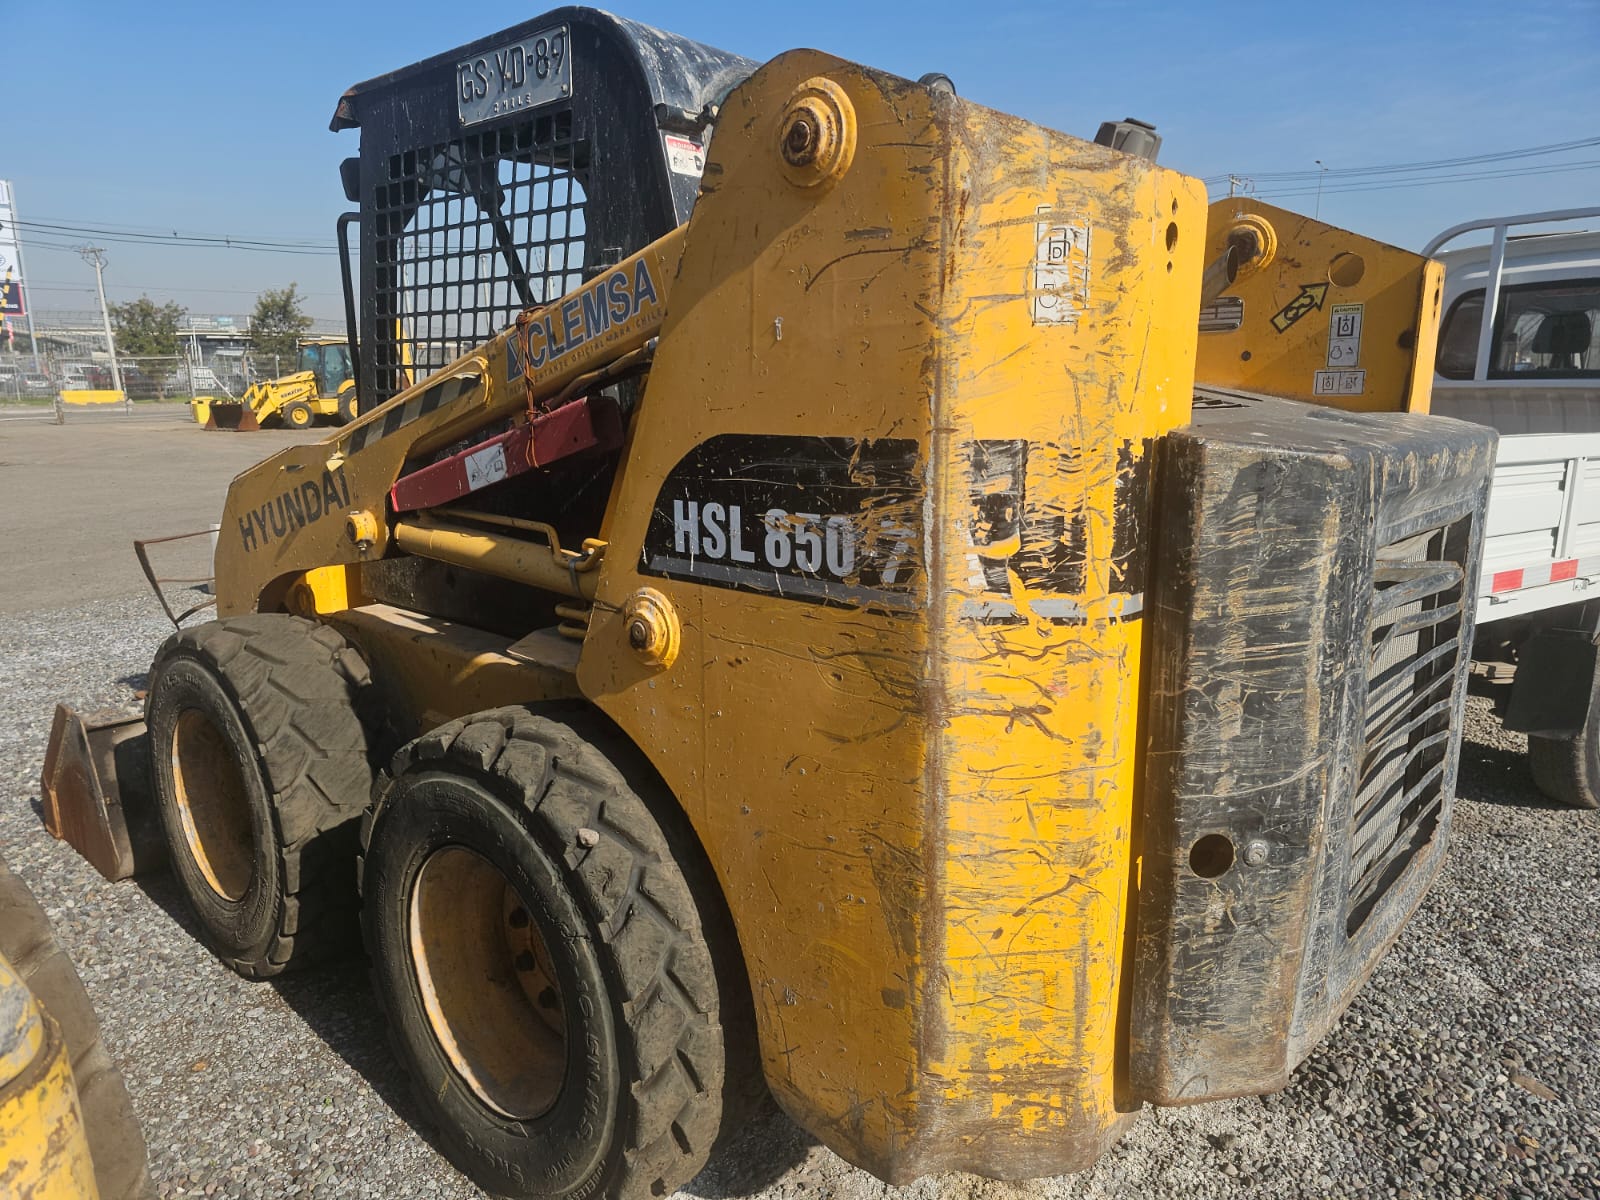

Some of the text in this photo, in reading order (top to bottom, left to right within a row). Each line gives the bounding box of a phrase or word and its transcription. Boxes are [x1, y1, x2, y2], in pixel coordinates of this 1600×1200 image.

[527, 257, 658, 370] CLEMSA
[238, 465, 351, 553] HYUNDAI
[673, 499, 756, 564] HSL
